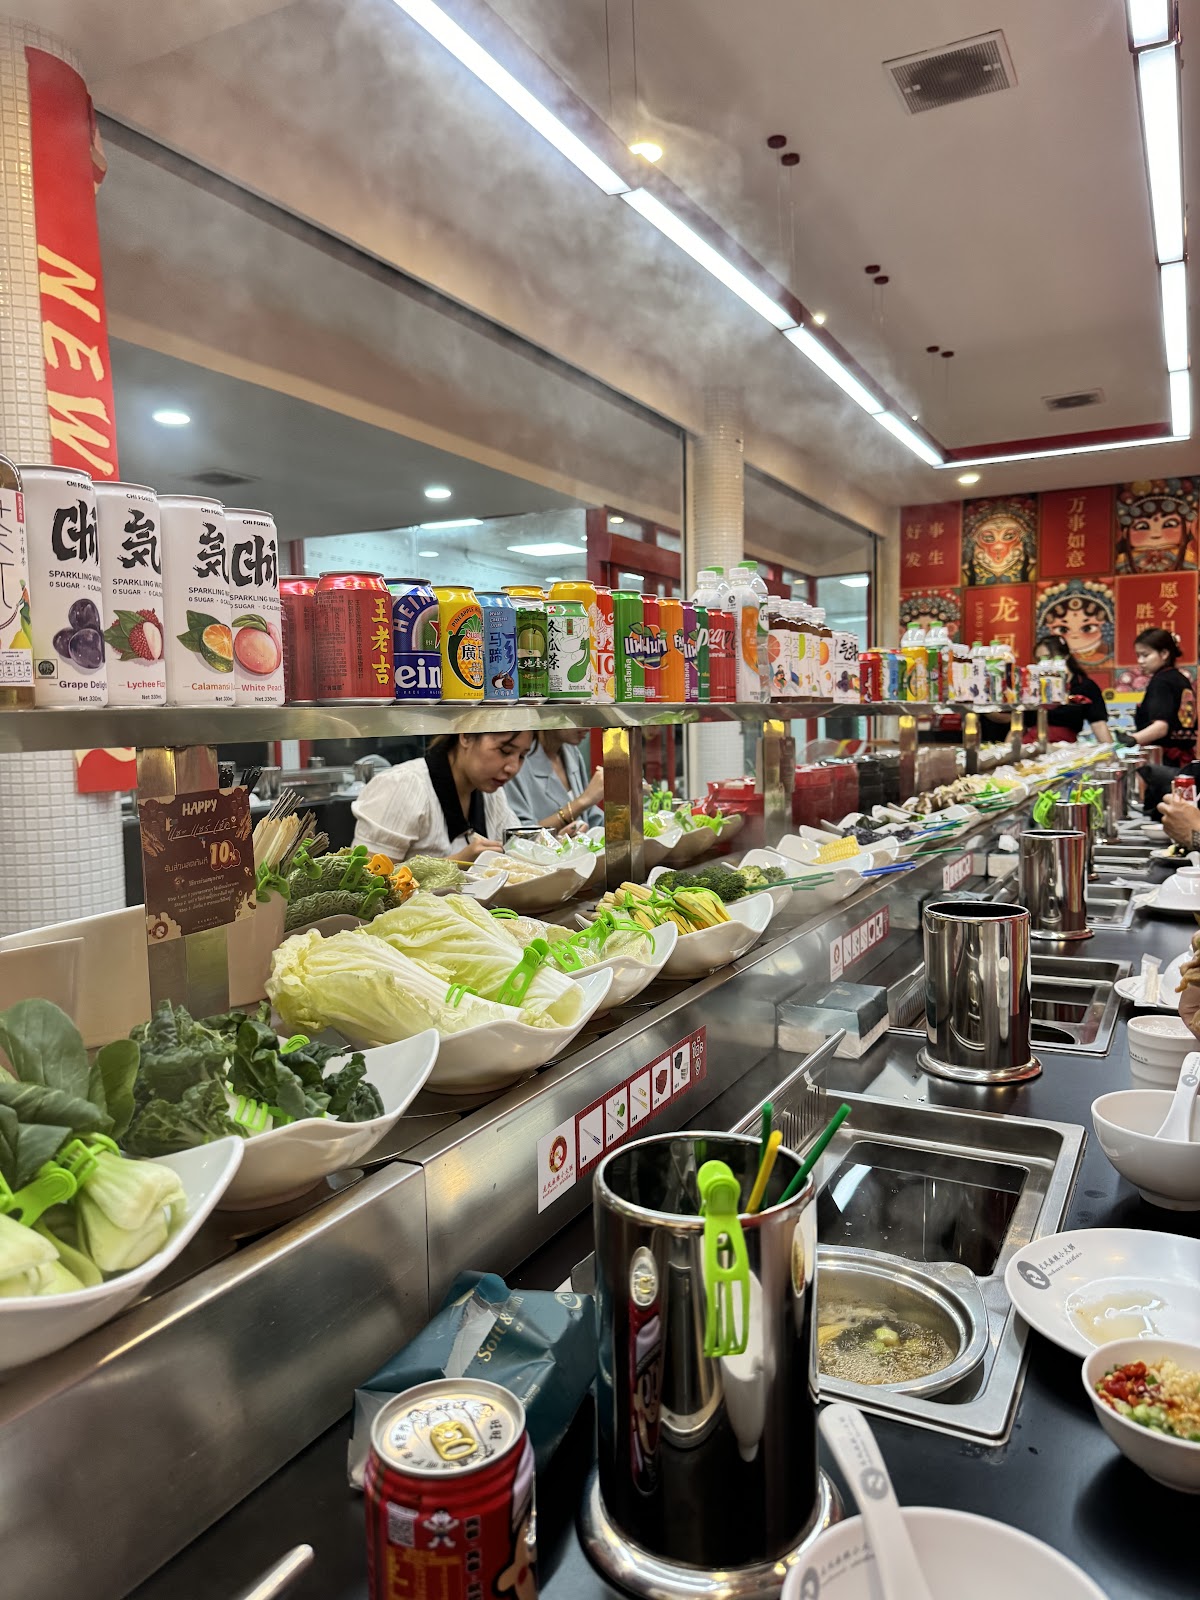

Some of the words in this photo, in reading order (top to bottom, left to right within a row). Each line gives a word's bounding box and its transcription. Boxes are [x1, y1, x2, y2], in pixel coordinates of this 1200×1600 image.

[38, 244, 114, 476] NEW
[1066, 496, 1087, 568] 万事如意
[231, 534, 279, 590] Chi
[49, 570, 92, 581] SPARKLING
[56, 581, 80, 589] SUGAR
[112, 578, 154, 588] SPARKLING
[188, 586, 225, 597] SPARKLING
[229, 593, 268, 602] SPARKLING
[370, 597, 391, 685] 王老吉
[547, 619, 562, 671] 冬瓜茶
[59, 680, 89, 690] Grape
[126, 680, 156, 690] Lychee
[241, 683, 266, 692] White
[182, 798, 218, 817] HAPPY
[210, 841, 237, 866] 10%
